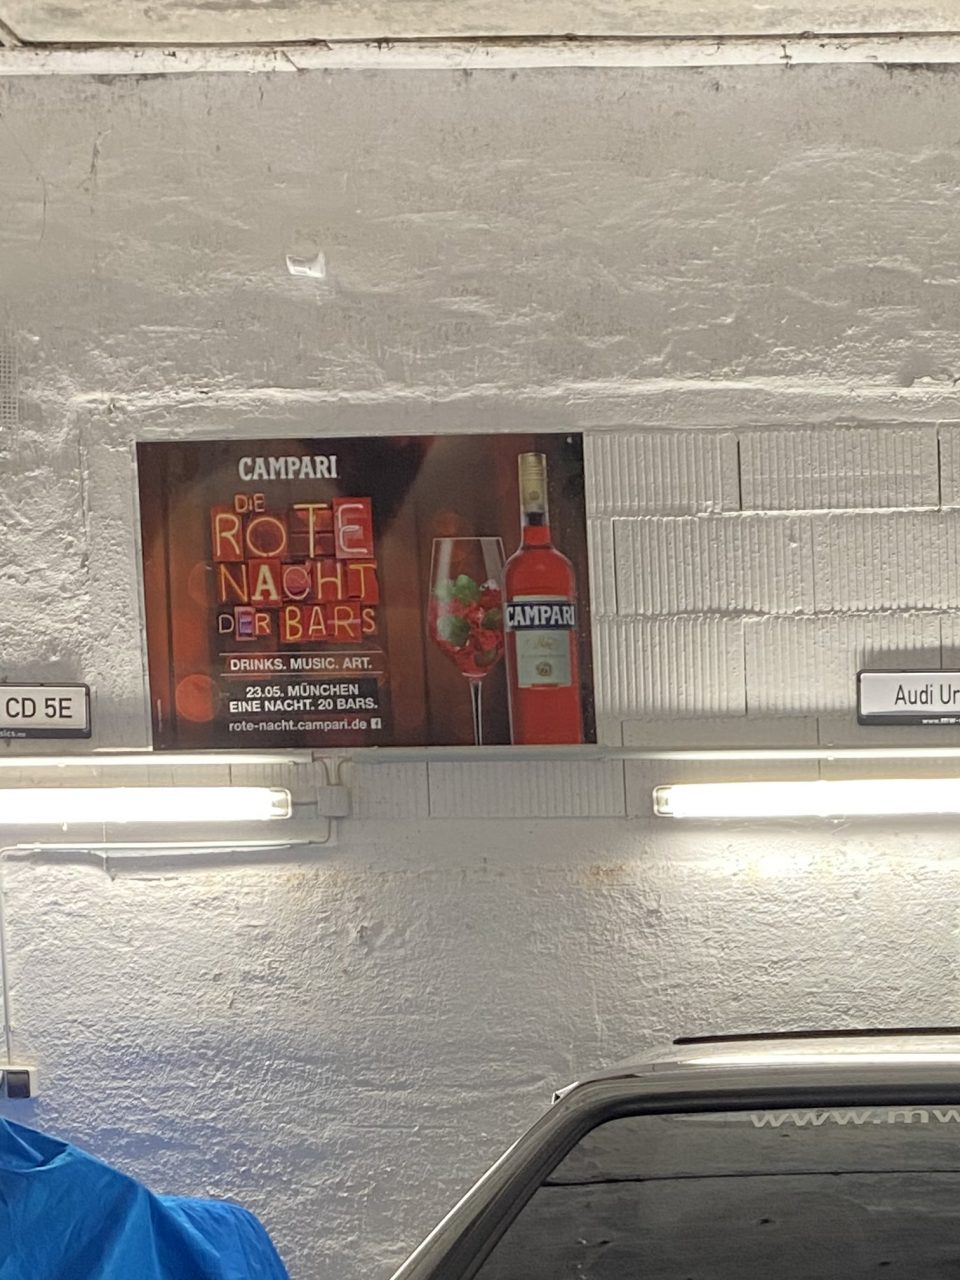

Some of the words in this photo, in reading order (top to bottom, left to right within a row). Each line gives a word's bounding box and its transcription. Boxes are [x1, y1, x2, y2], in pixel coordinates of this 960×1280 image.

[239, 455, 338, 481] CAMPARI
[234, 493, 265, 513] DIE
[216, 503, 370, 559] ROTE
[218, 563, 376, 602] NACHT
[218, 612, 271, 640] DER
[285, 606, 376, 642] BARS
[506, 606, 576, 626] CAMPARI
[230, 657, 286, 671] DRINKS.
[290, 657, 339, 670] MUSIC.
[342, 656, 373, 670] ART.
[246, 686, 284, 698] 23.05.
[287, 683, 359, 698] MÜNCHEN
[894, 684, 934, 705] Audi
[6, 697, 36, 718] CD
[45, 698, 73, 718] 5E
[229, 700, 260, 713] EINE
[264, 699, 315, 712] NACHT.
[318, 698, 334, 710] 20
[336, 698, 379, 710] BARS.
[229, 718, 367, 732] rote-nacht.campari.de
